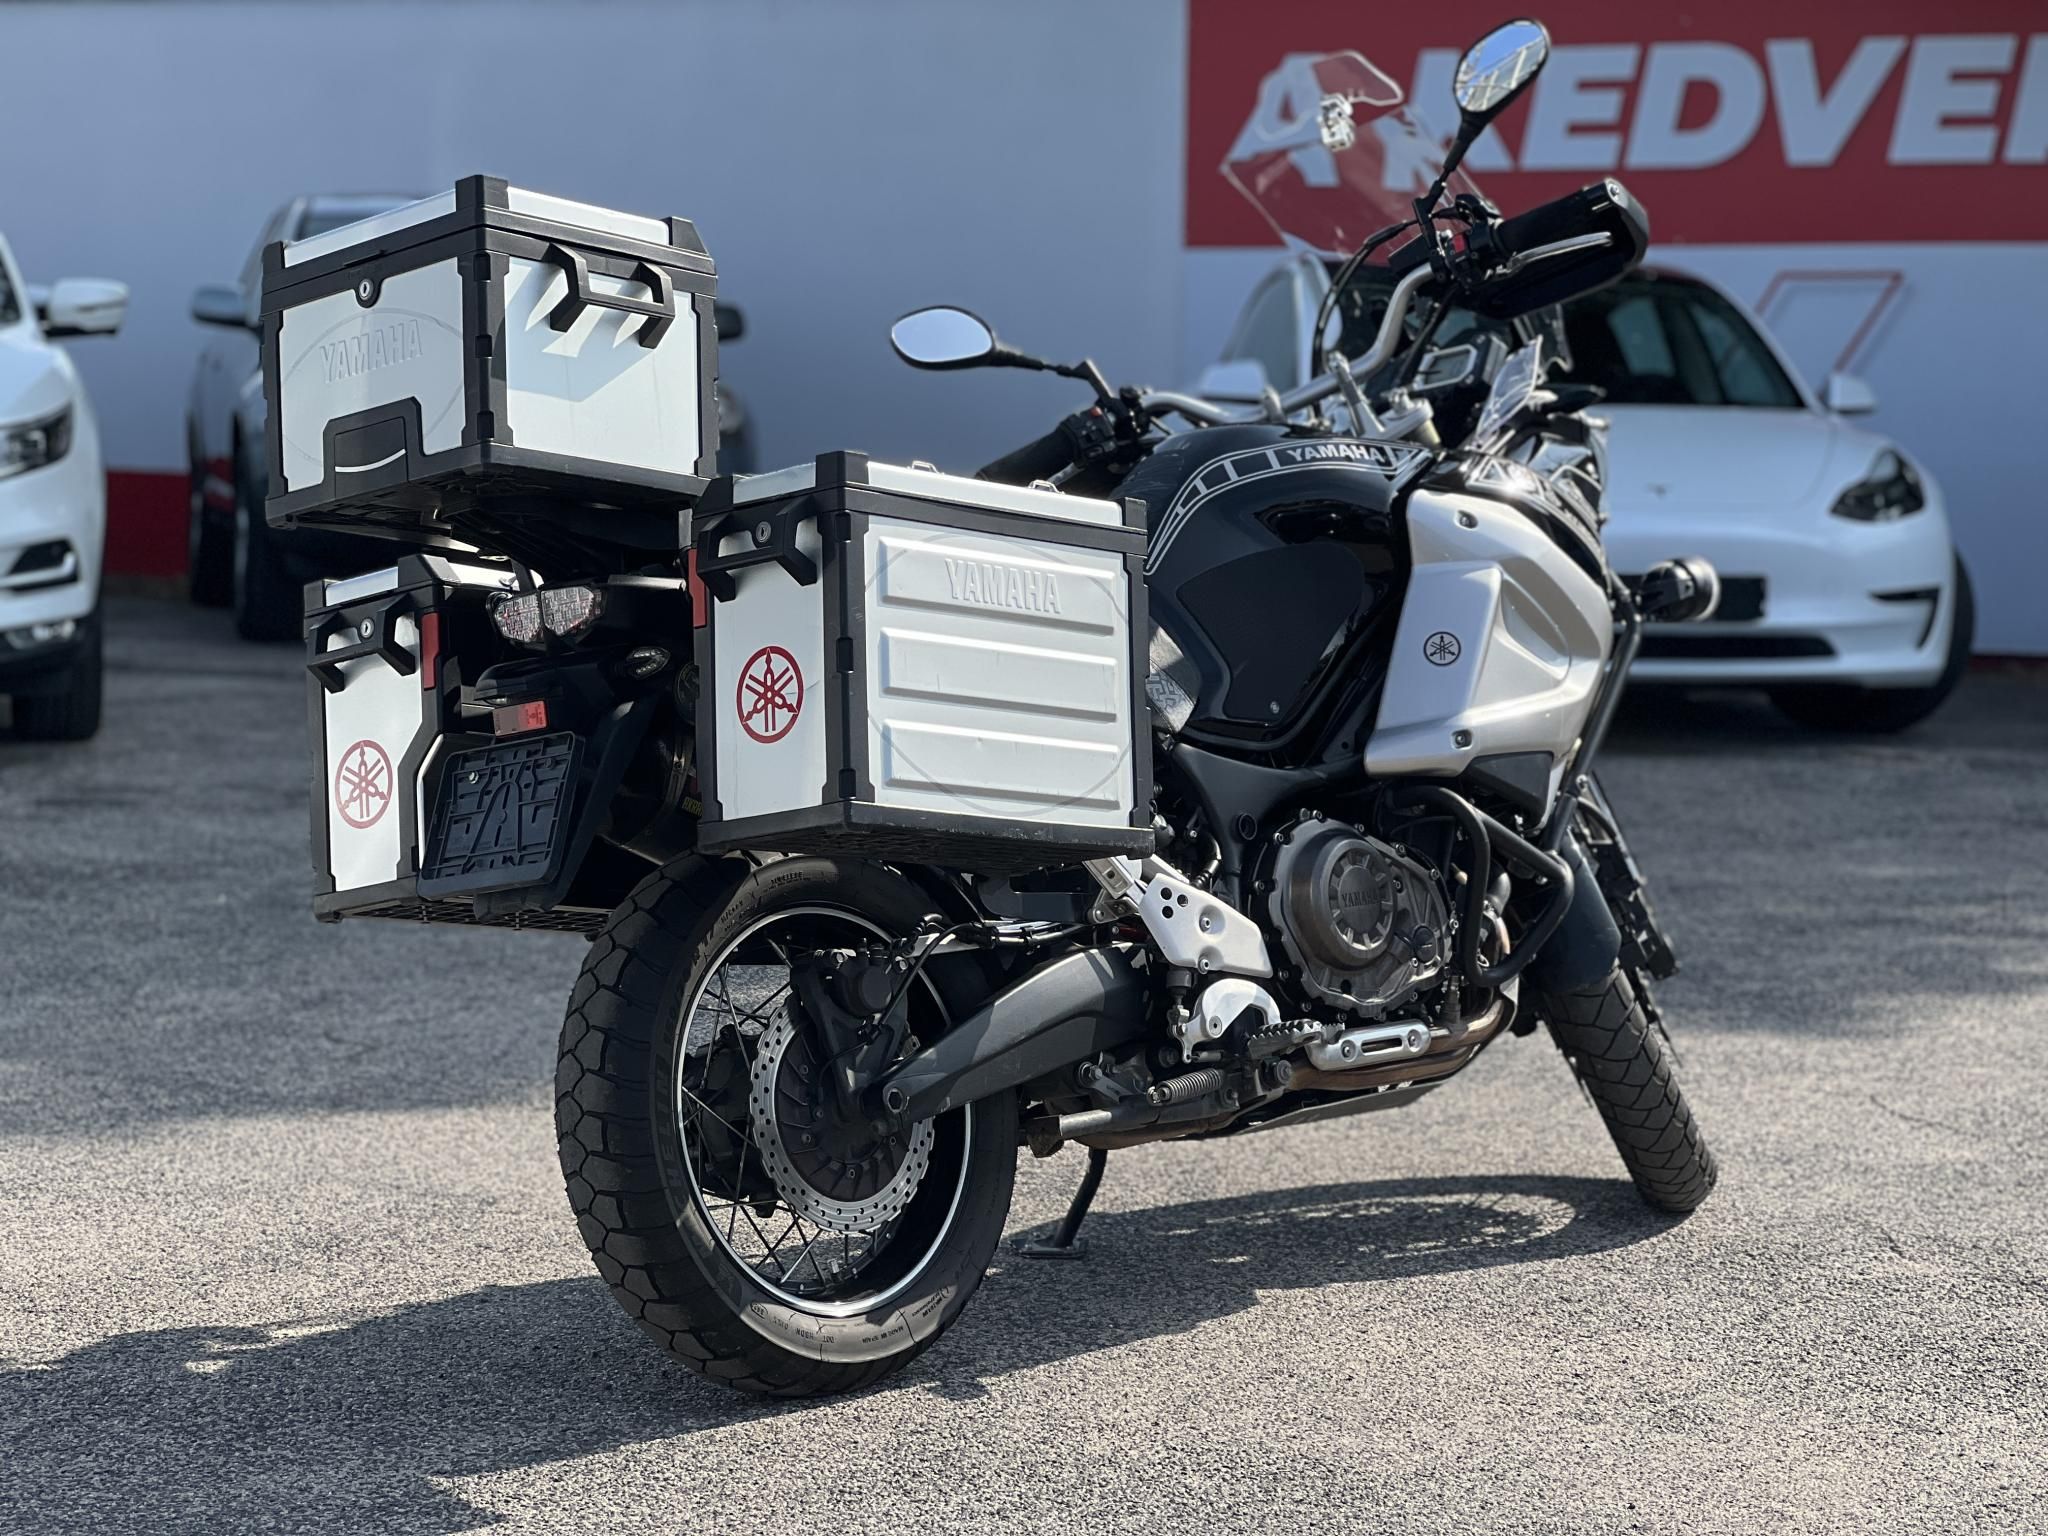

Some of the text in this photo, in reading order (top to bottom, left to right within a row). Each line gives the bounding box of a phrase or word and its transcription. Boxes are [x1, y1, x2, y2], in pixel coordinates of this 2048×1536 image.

[1374, 33, 2048, 191] KEDVE
[320, 318, 424, 384] YAMAHA
[1286, 443, 1386, 463] YAMAHA
[944, 558, 1062, 615] YAMAHA
